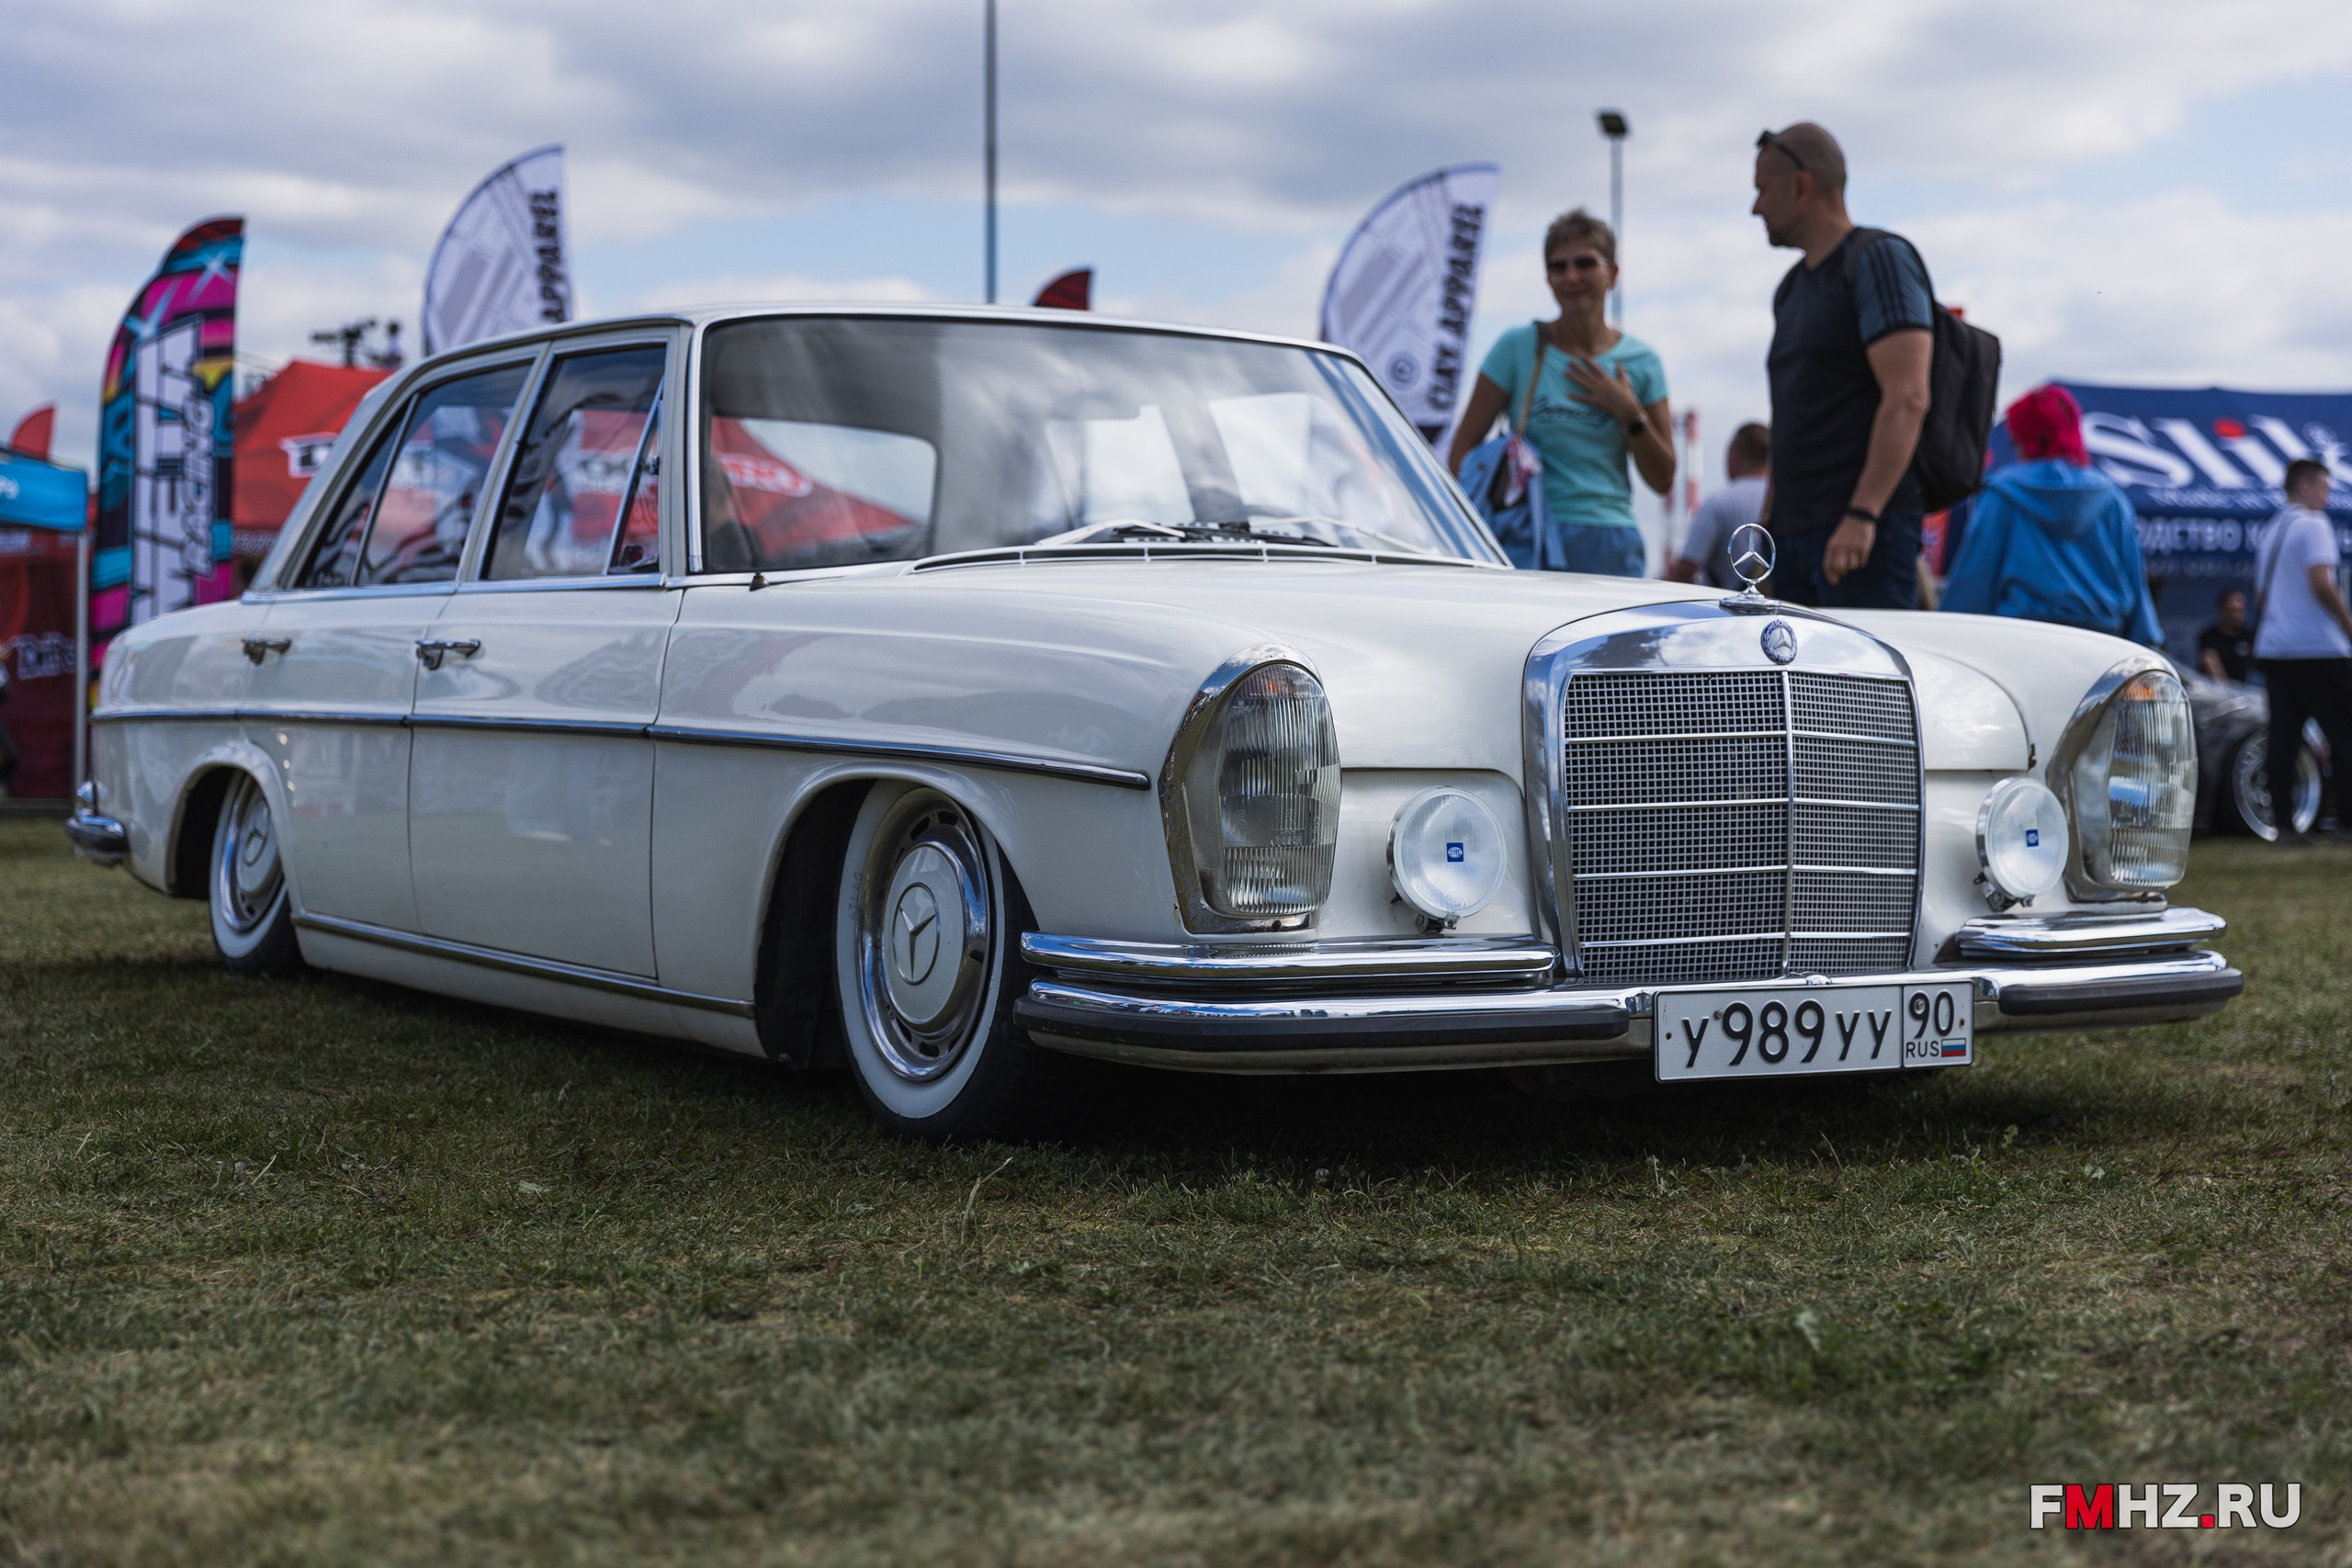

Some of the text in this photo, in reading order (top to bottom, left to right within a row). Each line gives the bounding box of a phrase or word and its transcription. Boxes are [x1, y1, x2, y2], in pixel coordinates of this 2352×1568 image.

[181, 395, 214, 575] RACING
[1908, 991, 1955, 1039] 90
[1905, 1040, 1940, 1058] RUS
